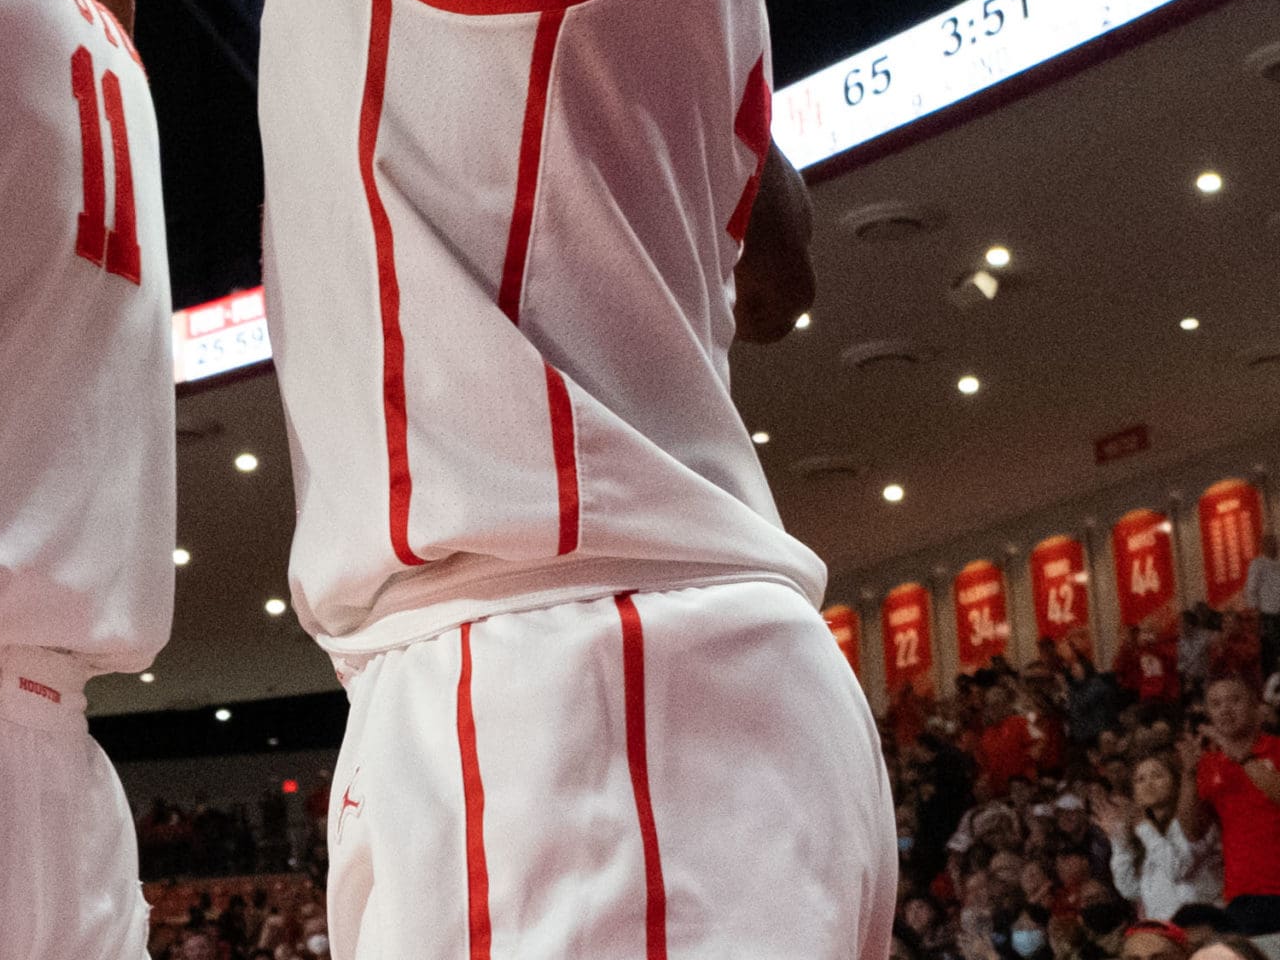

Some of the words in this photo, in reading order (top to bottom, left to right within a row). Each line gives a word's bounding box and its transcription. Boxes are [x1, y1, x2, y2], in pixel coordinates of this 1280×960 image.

[843, 55, 893, 106] 65
[71, 45, 142, 286] 11
[1130, 555, 1161, 595] 44
[19, 676, 61, 704] HOUS
